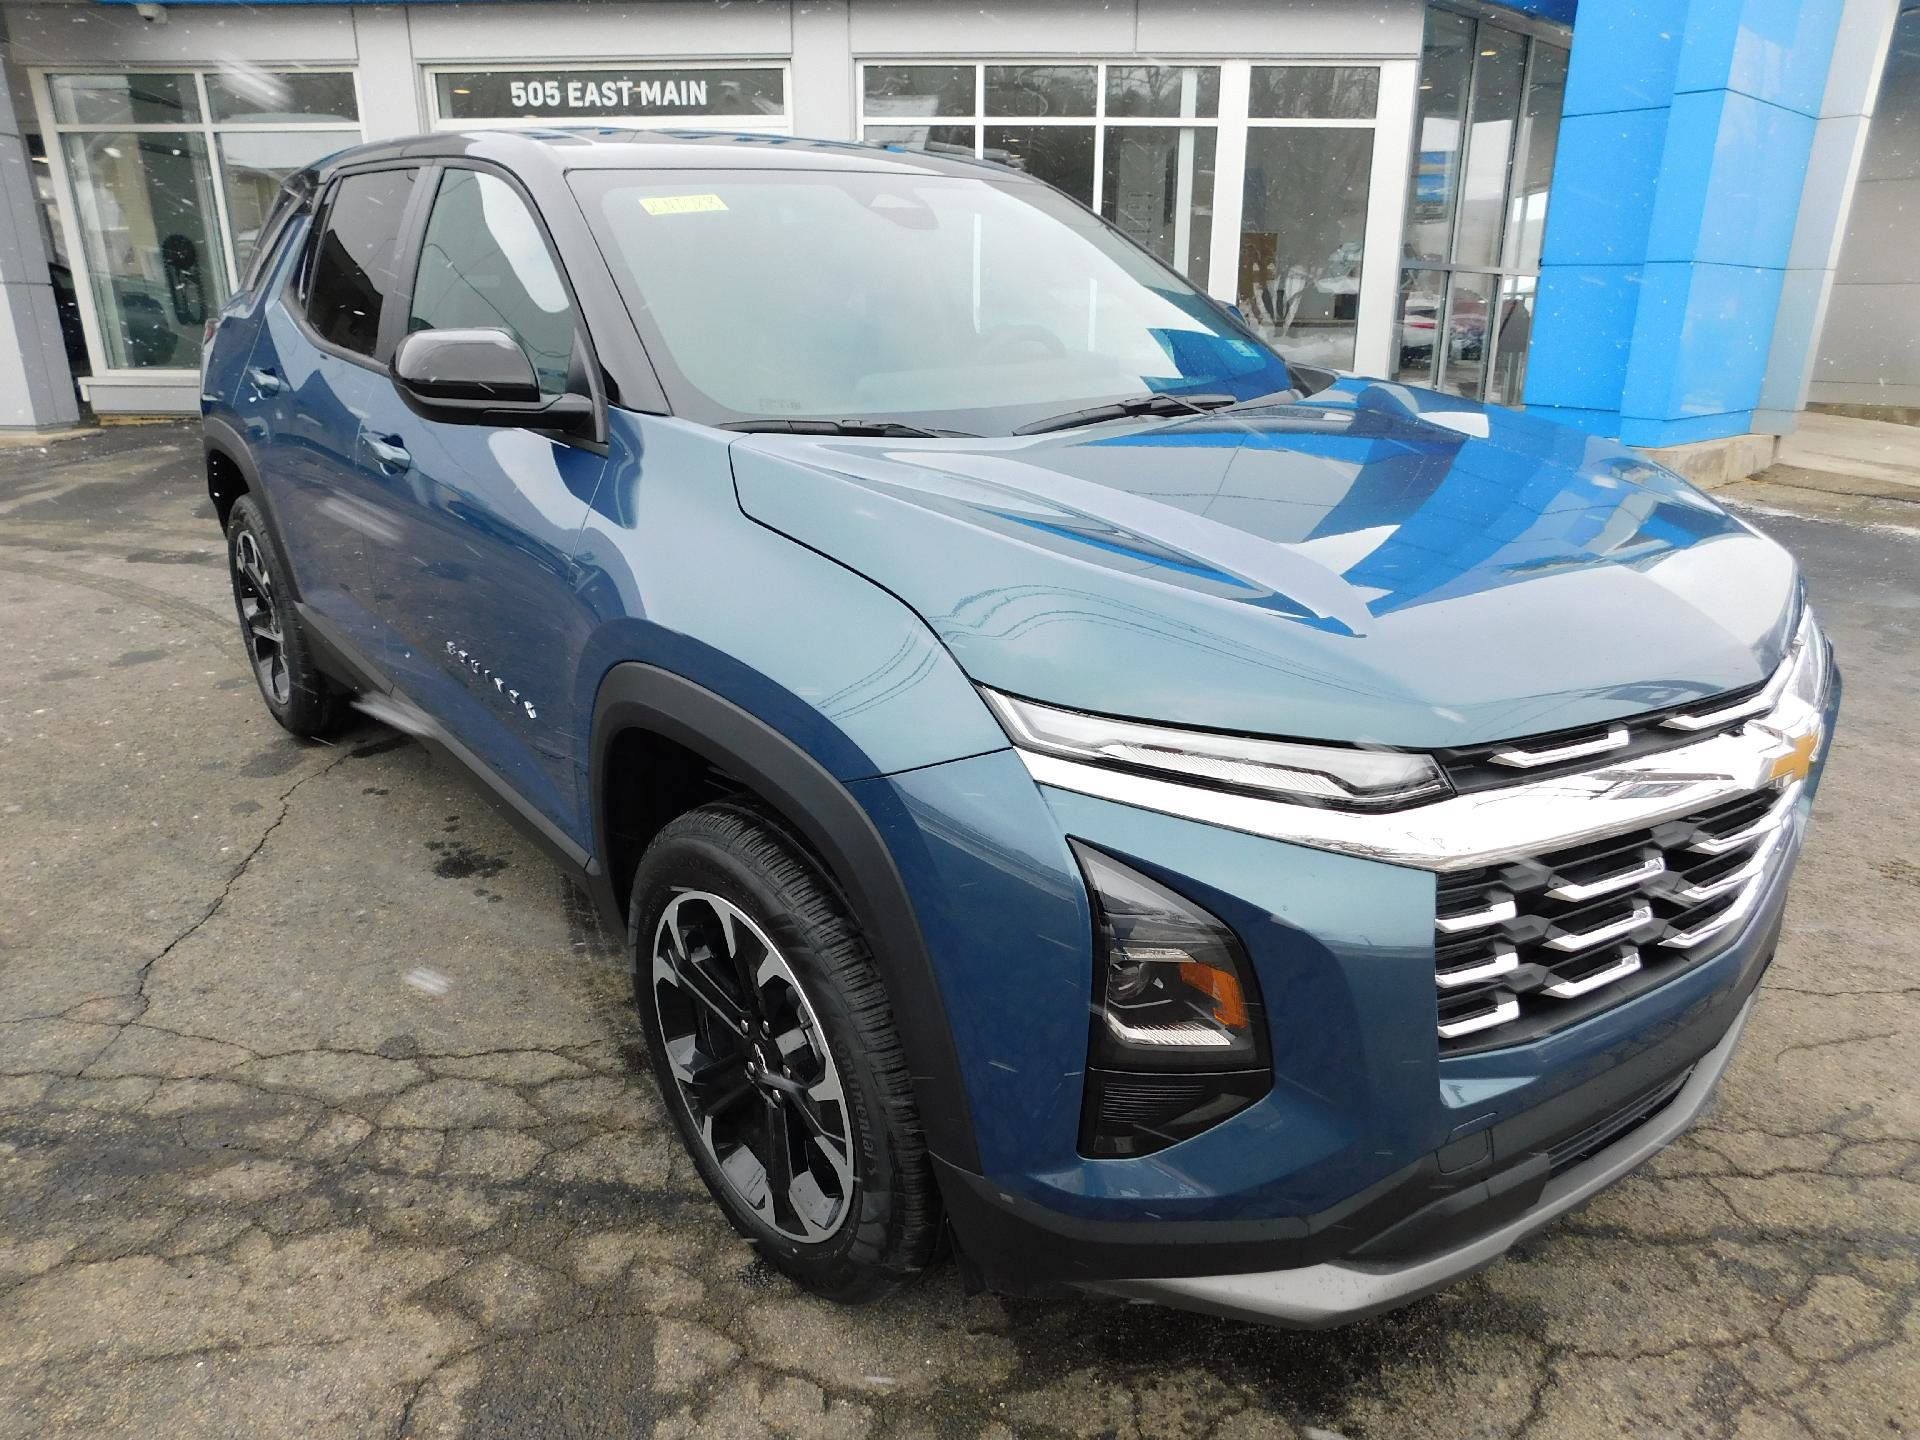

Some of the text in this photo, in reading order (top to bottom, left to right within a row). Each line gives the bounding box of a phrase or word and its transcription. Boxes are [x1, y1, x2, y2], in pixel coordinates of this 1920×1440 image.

[510, 80, 708, 107] 505 EAST MAIN
